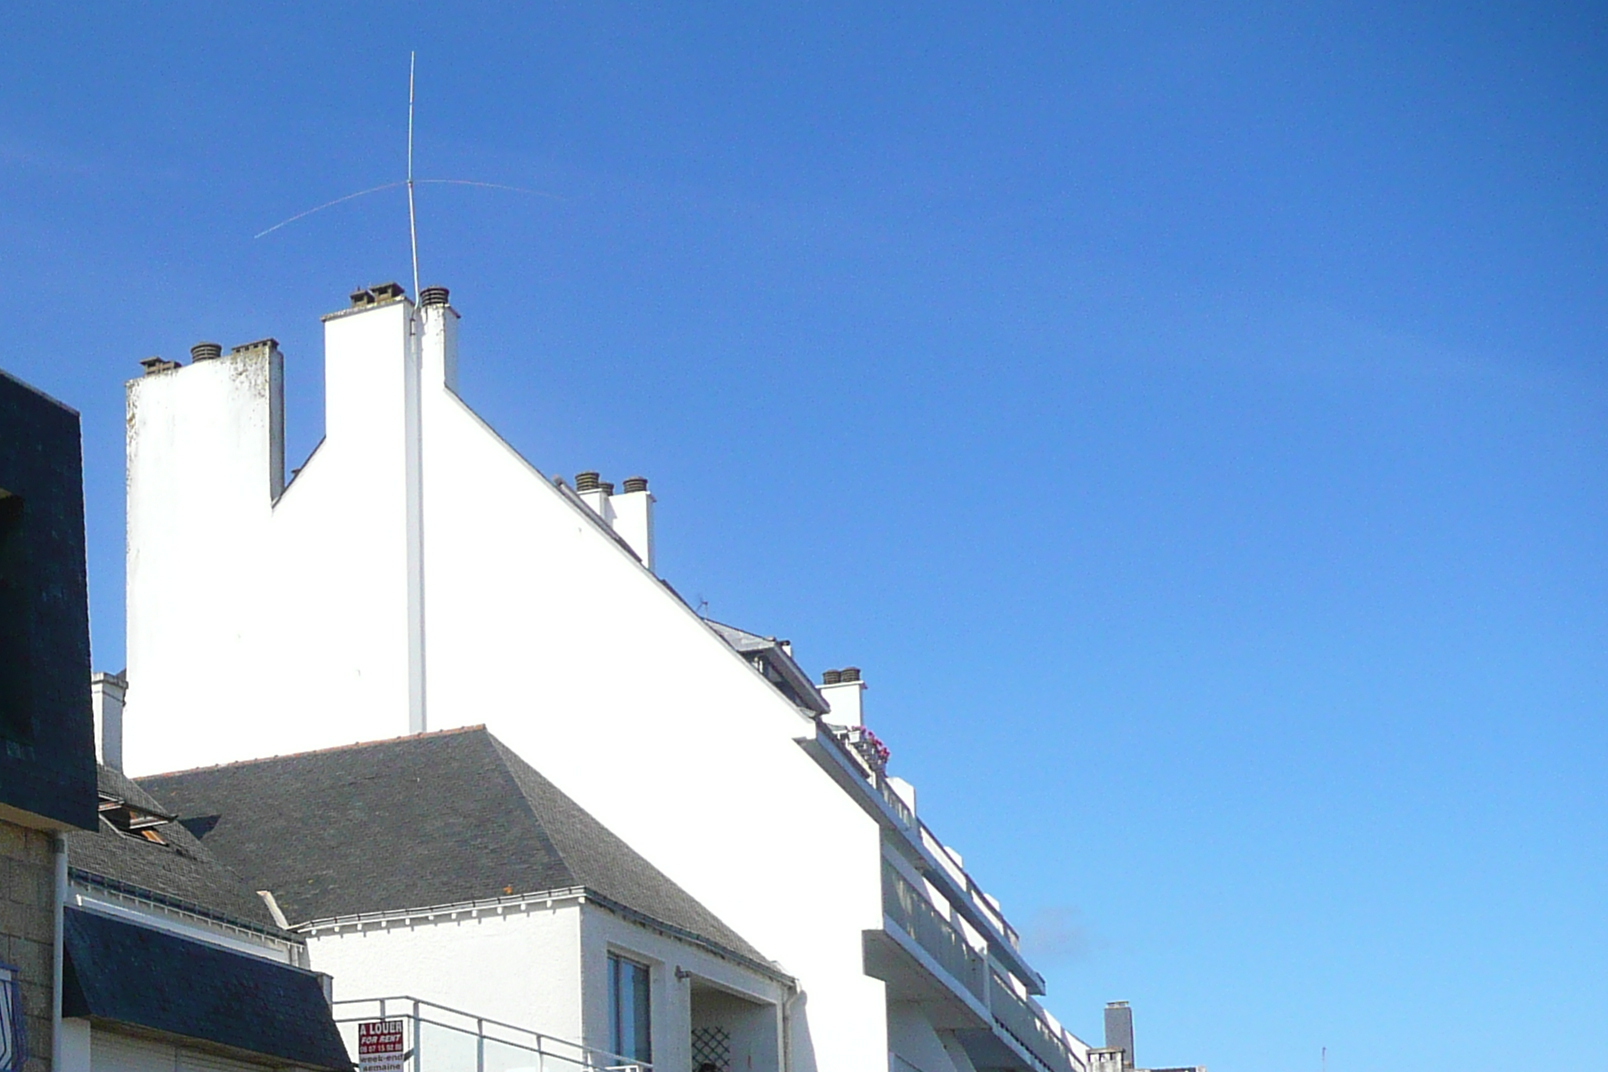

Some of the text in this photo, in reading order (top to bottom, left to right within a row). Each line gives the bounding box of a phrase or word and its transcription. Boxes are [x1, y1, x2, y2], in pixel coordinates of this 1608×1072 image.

[369, 1021, 402, 1035] LOUER
[361, 1034, 401, 1045] FOR RENT
[360, 1054, 404, 1063] week-end
[363, 1064, 401, 1072] semaine
